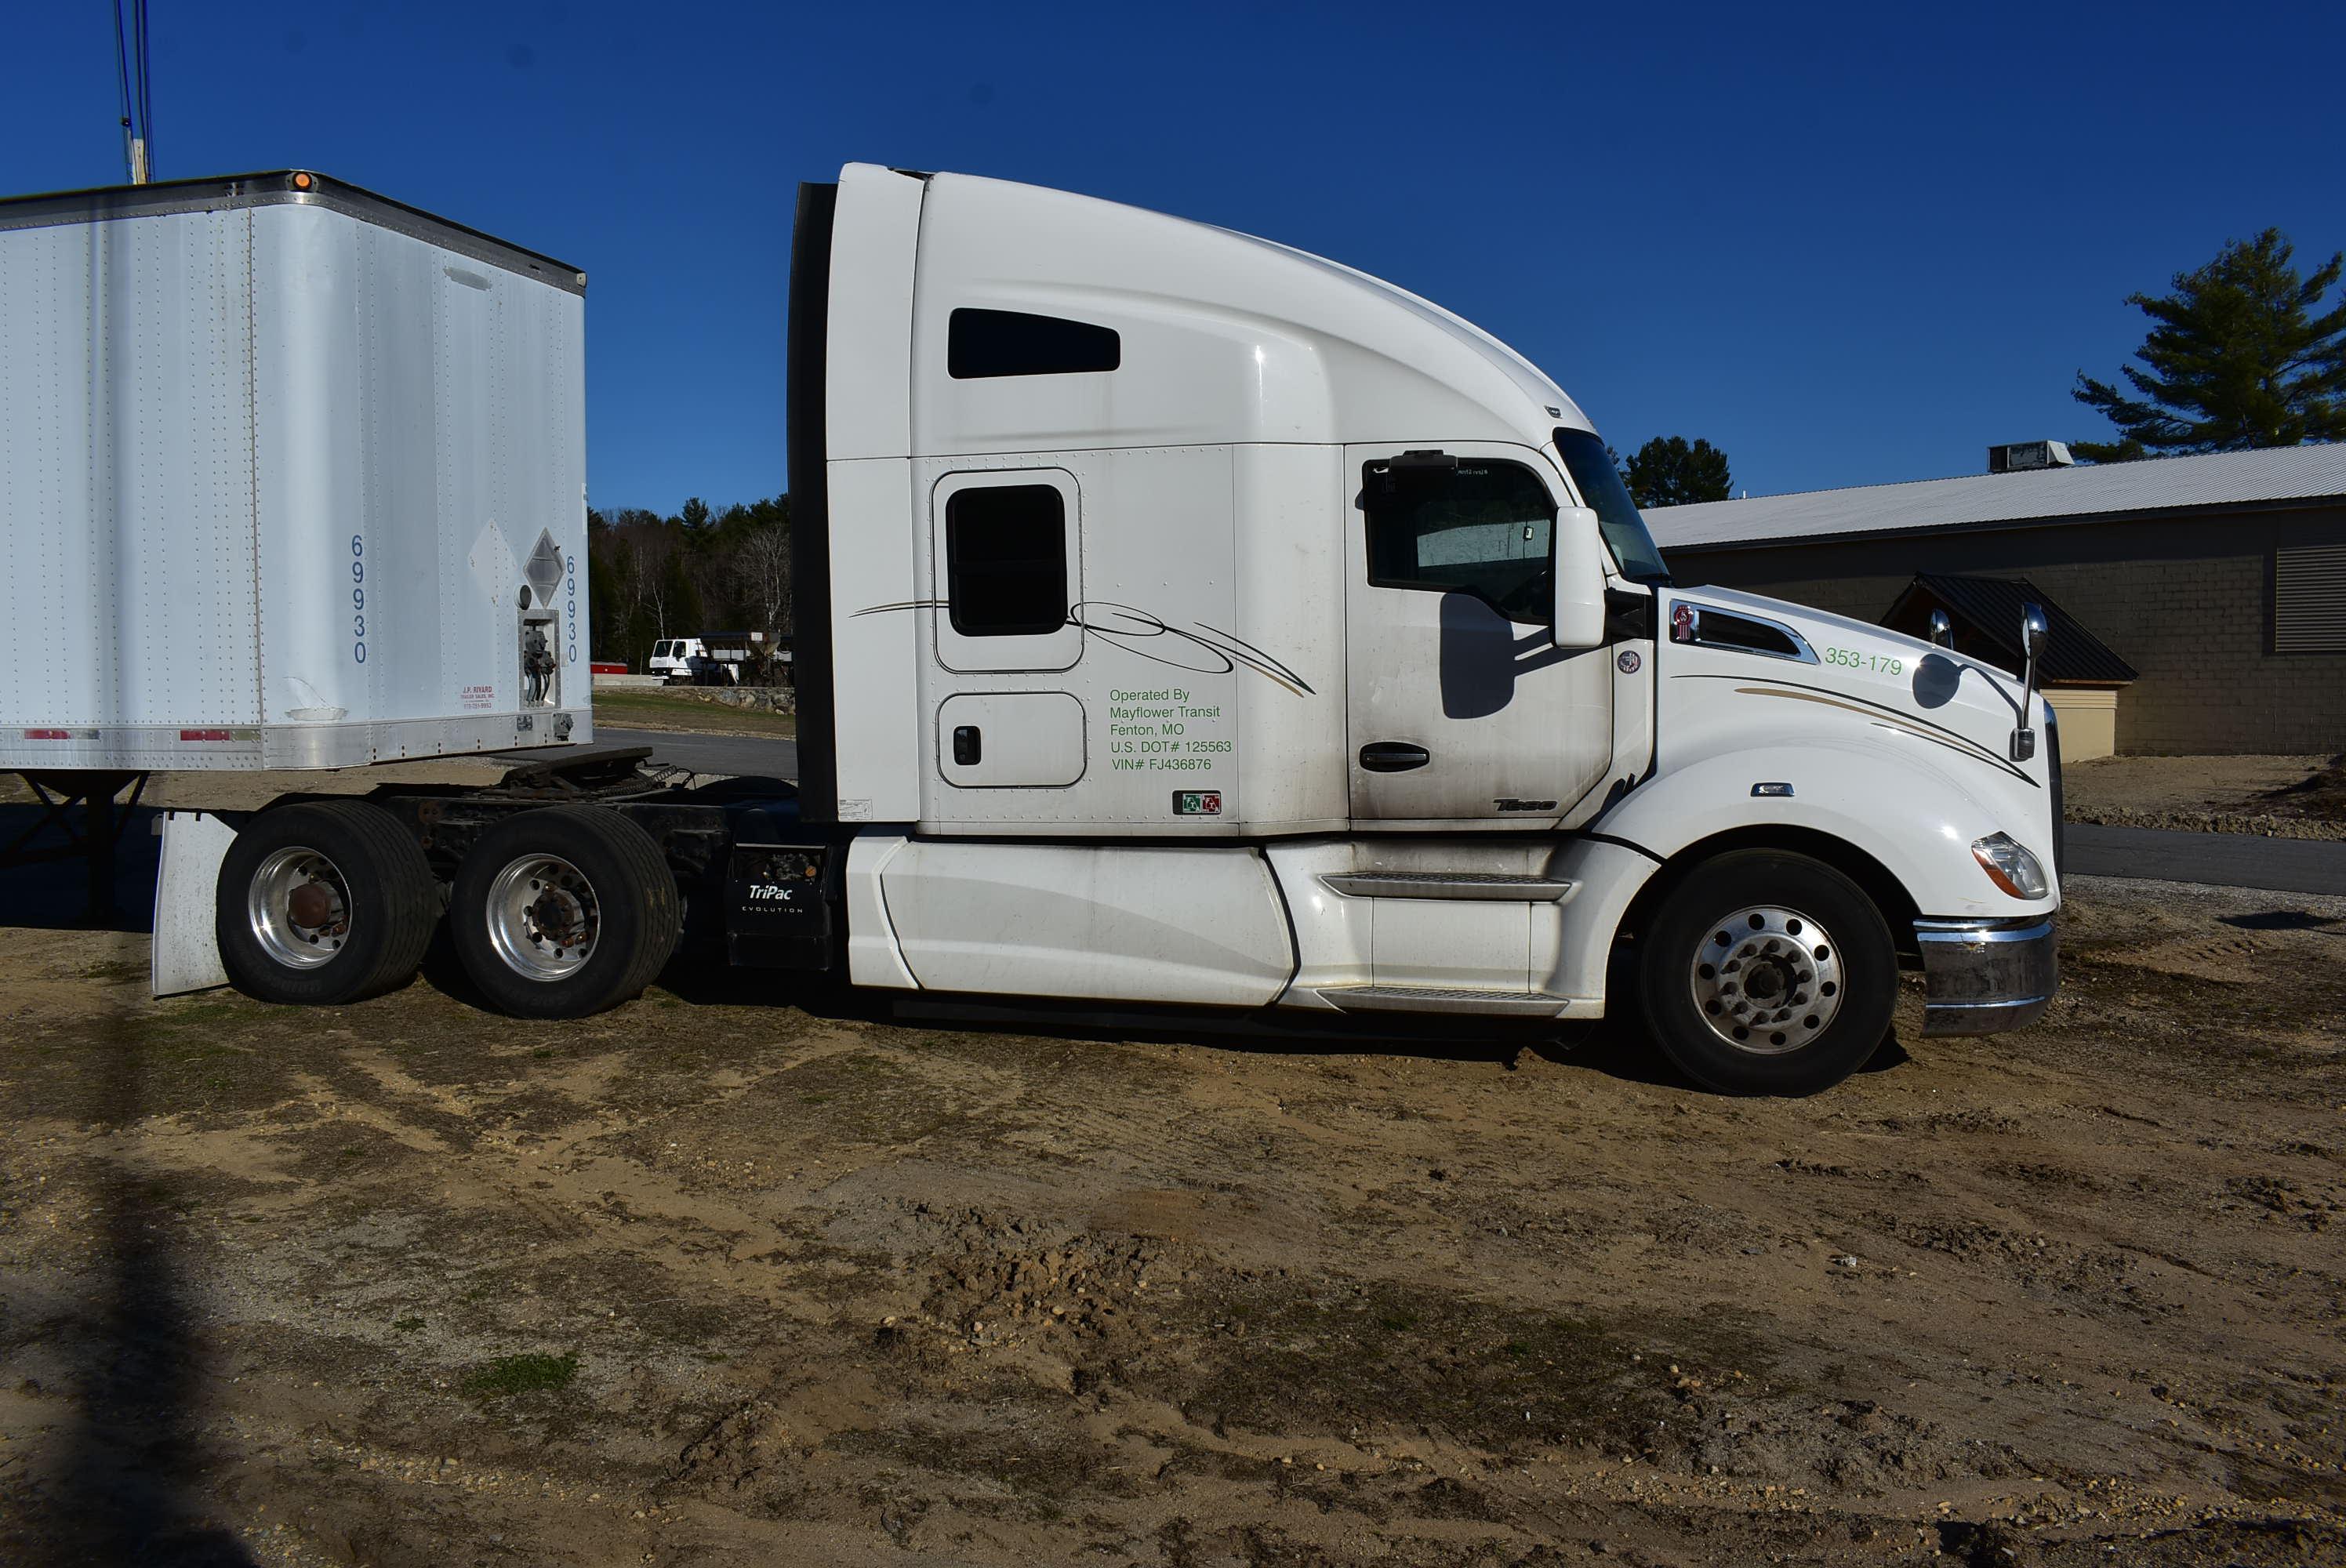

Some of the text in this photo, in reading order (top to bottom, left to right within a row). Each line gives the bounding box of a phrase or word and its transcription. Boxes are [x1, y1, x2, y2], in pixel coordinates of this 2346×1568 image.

[351, 535, 367, 664] 69930
[566, 556, 577, 662] 69930
[1825, 647, 1902, 676] 353-179
[1109, 688, 1189, 703] Operated By
[1109, 706, 1220, 720] Mayflower Transit
[1110, 723, 1184, 737] Fenton, MO
[1111, 740, 1232, 753] U.S. DOT# 125563
[1112, 758, 1211, 770] VIN# FJ436876
[749, 884, 793, 900] TriPac
